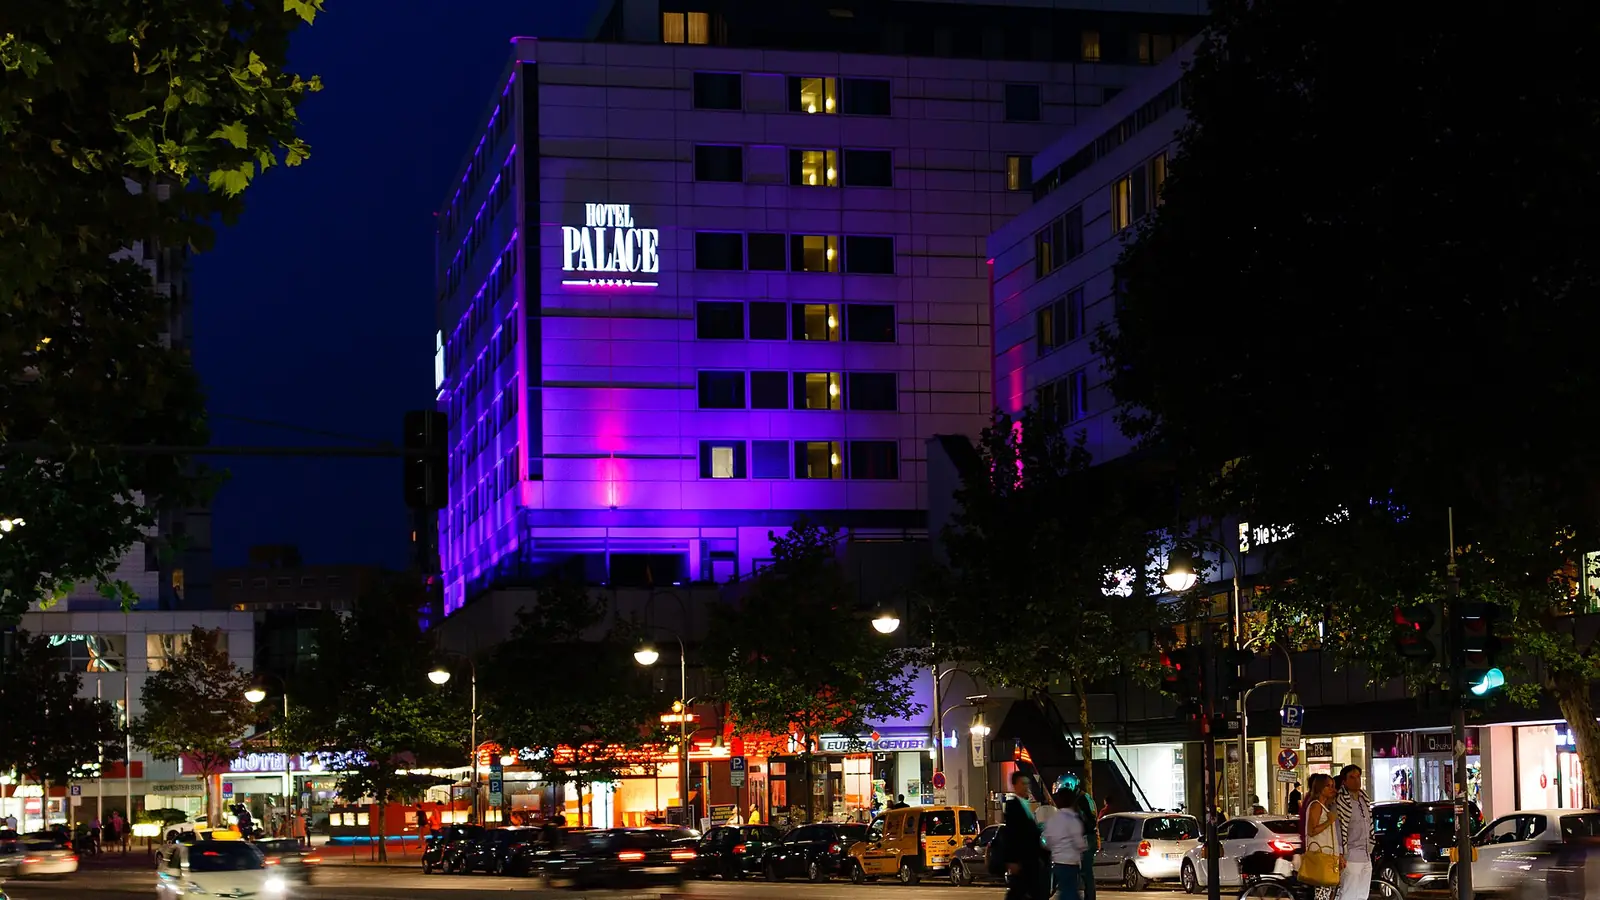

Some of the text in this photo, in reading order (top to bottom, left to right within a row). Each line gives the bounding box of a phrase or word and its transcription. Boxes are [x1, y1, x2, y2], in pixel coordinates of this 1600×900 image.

[585, 203, 634, 227] HOTEL
[562, 226, 659, 273] PALACE
[879, 739, 924, 750] CENTER
